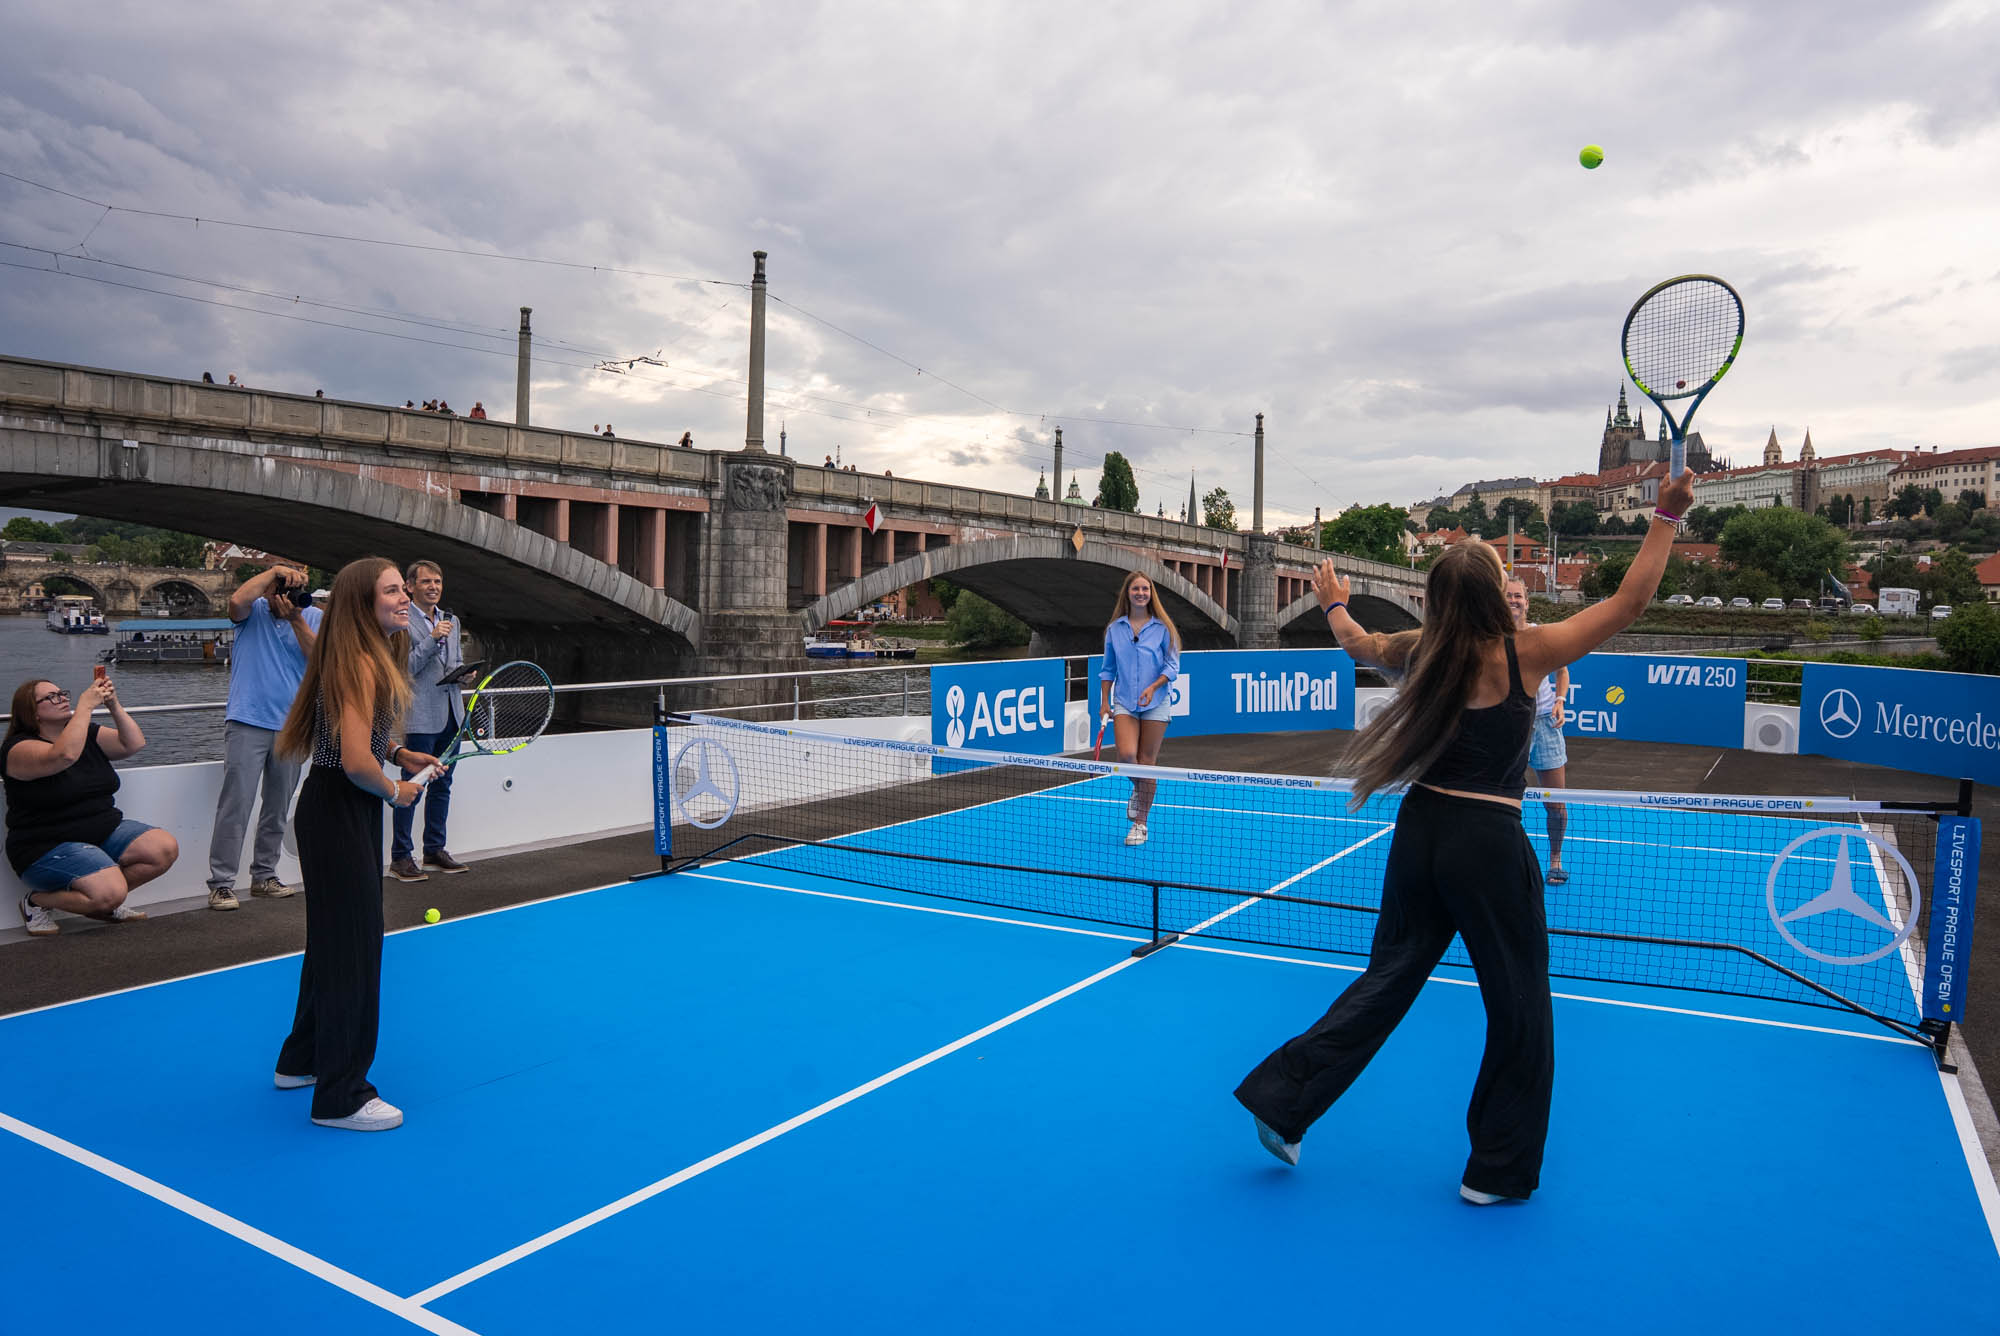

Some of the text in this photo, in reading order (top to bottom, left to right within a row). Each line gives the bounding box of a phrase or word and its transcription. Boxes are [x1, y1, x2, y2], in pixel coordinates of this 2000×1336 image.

[1647, 664, 1736, 688] WTA 250
[1231, 670, 1337, 713] ThinkPad
[968, 686, 1054, 740] AGEL
[1564, 709, 1617, 733] PEN
[706, 718, 788, 736] LIVESPORT PRAGUE OPEN
[1873, 701, 2000, 750] Mercede
[843, 737, 938, 755] LIVESPORT PRAGUE OPEN
[1003, 755, 1112, 773] LIVESPORT PRAGUE OPEN
[1187, 771, 1312, 788] LIVESPORT PRAGUE OPEN
[655, 738, 667, 851] LIVESPORT PRAGUE OPEN
[1639, 795, 1802, 809] LIVESPORT PRAGUE OPEN
[1938, 824, 1966, 1001] LIVESPORT PRAGUE OPEN
